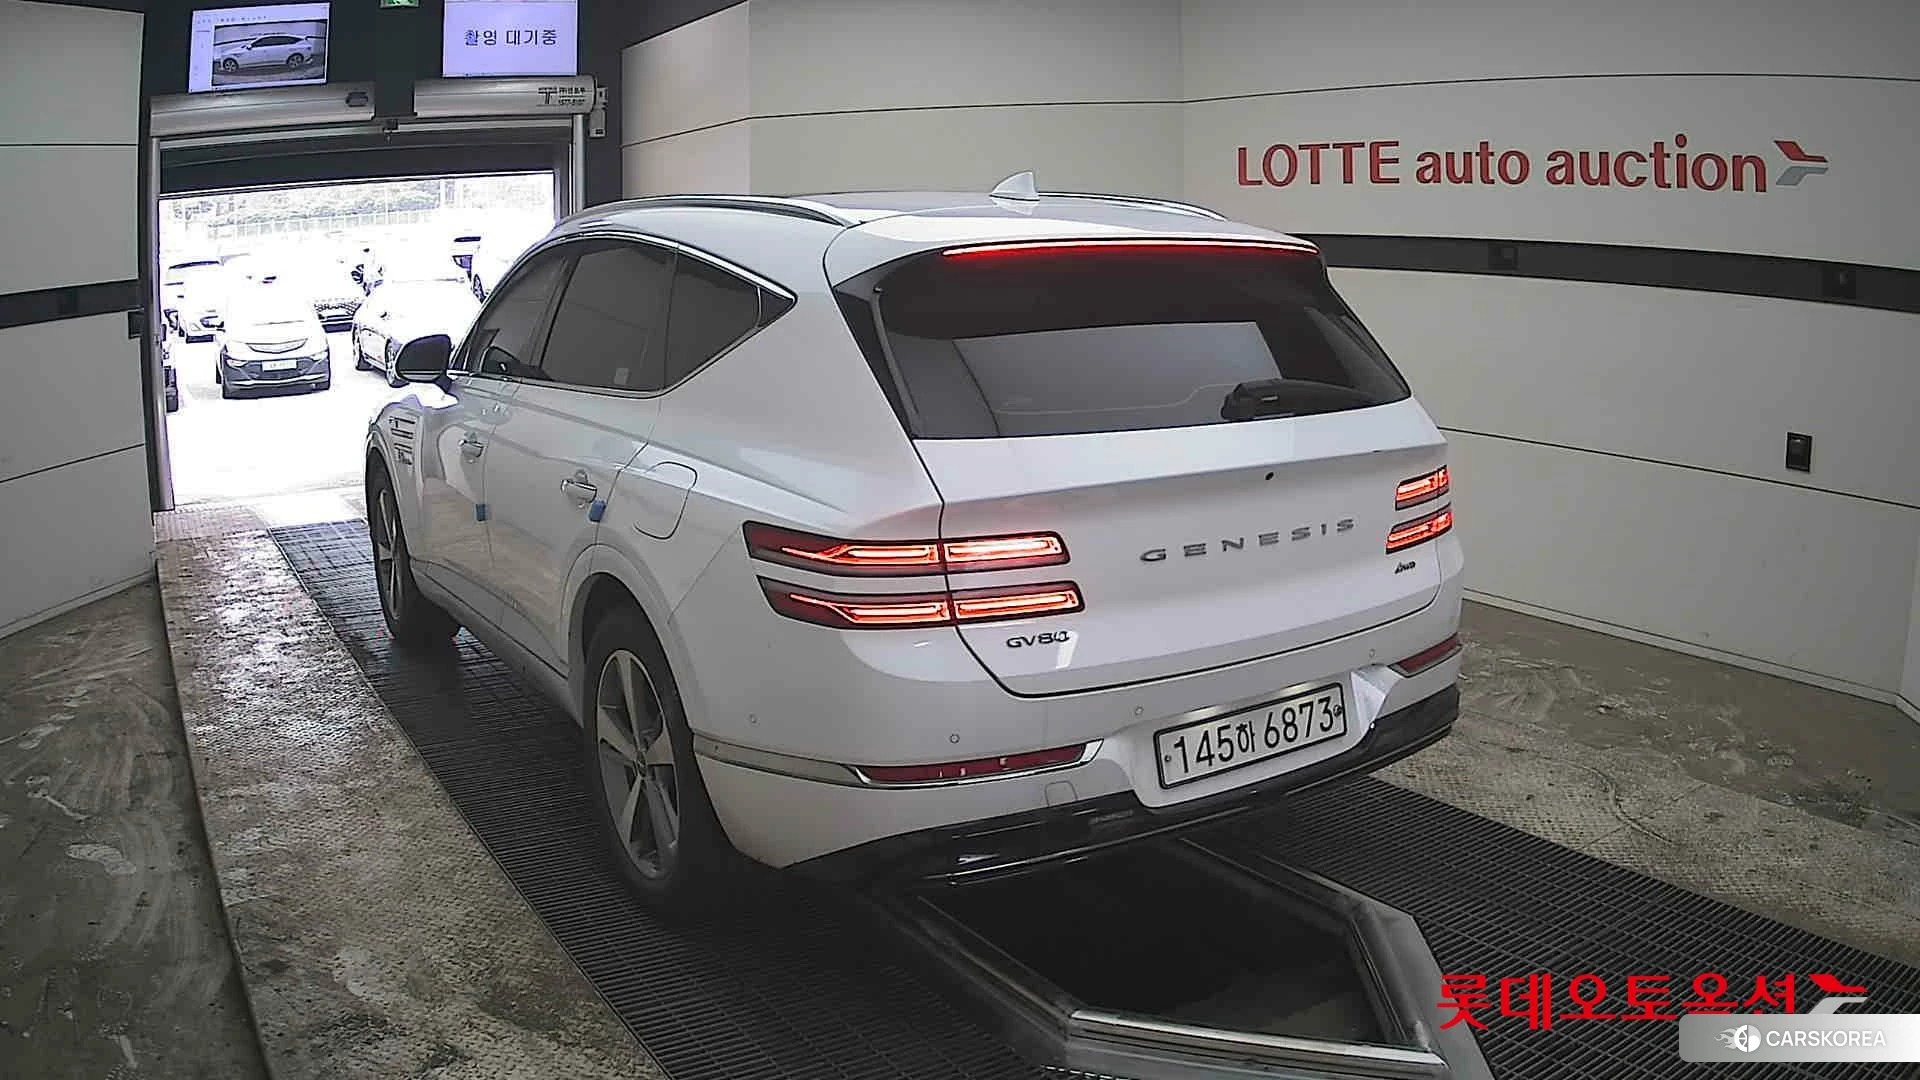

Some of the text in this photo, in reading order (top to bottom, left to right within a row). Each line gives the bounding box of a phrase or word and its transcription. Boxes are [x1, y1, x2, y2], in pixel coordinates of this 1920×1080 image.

[505, 29, 558, 46] 대기중
[1237, 133, 1768, 193] LOTTE auto auction
[1139, 518, 1355, 563] GENESIS
[1005, 630, 1071, 649] GV80
[1263, 695, 1335, 749] 6873
